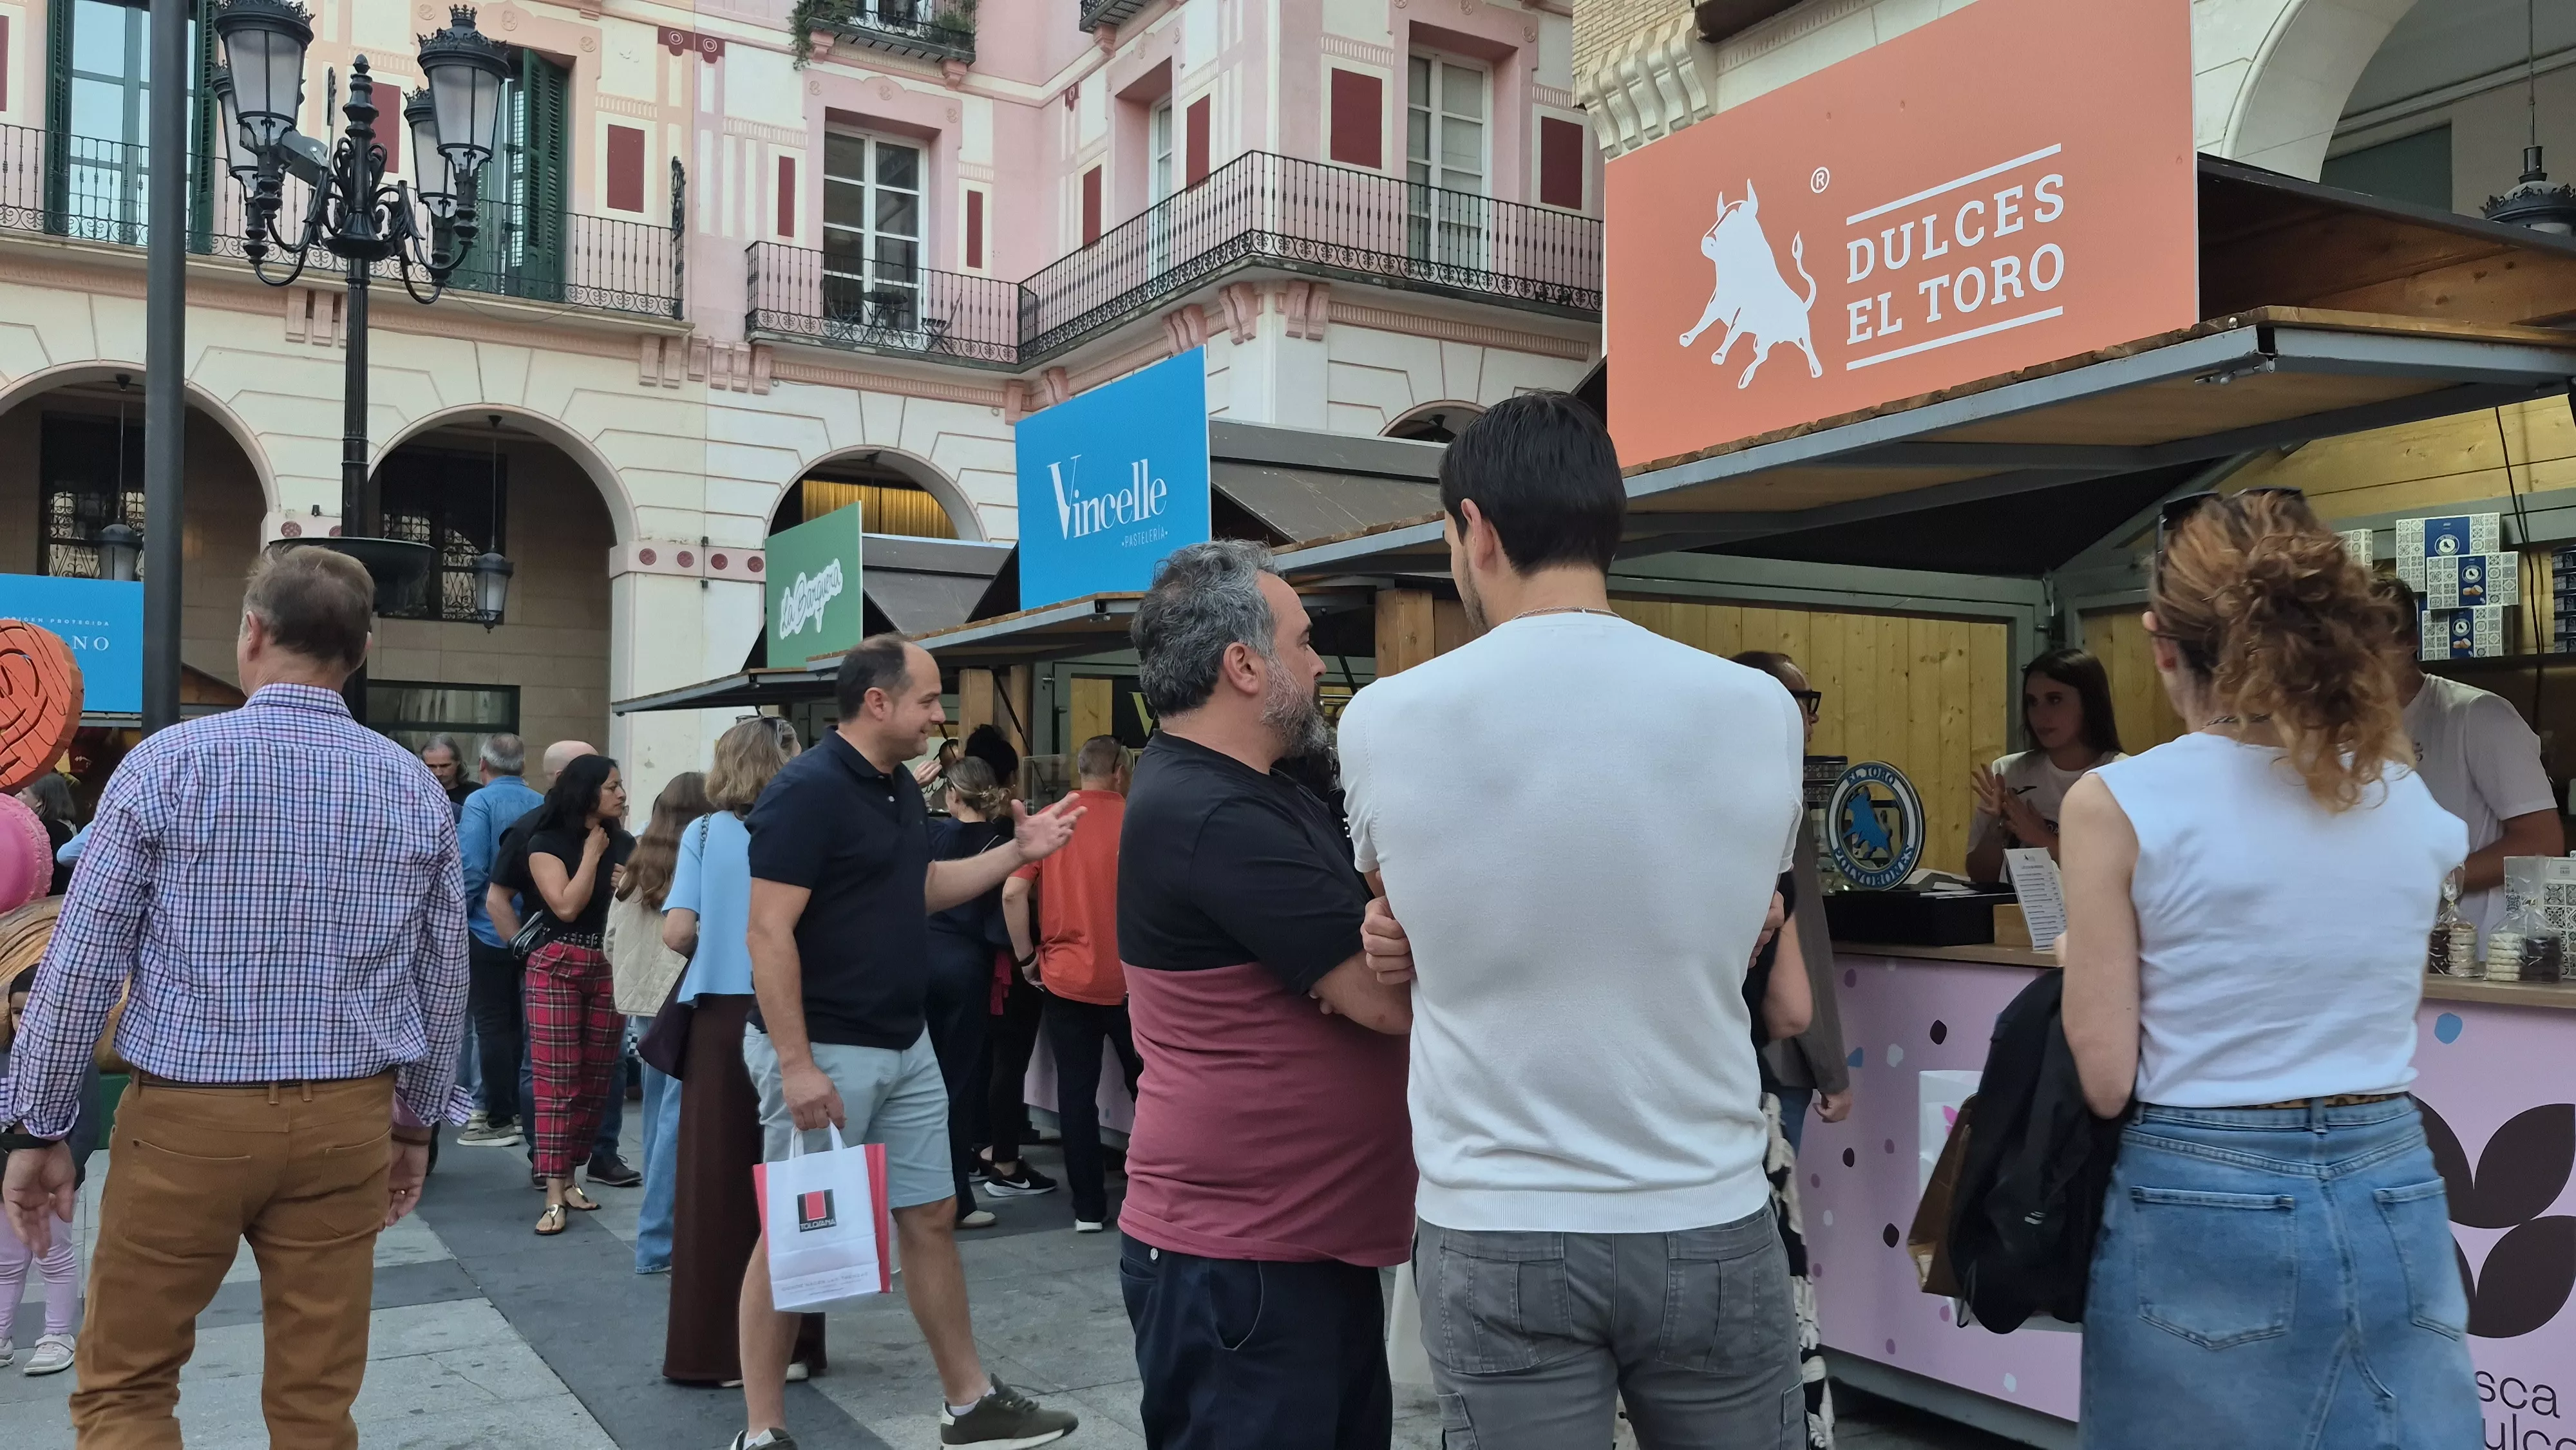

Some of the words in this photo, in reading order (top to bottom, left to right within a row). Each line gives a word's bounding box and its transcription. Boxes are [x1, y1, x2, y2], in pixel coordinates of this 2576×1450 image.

[1846, 174, 2064, 284] DULCES
[1846, 291, 1902, 345] EL
[1918, 243, 2065, 323] TORO
[1047, 455, 1167, 540] Vincelle
[781, 594, 795, 633] La
[794, 566, 841, 626] Barquera
[70, 635, 109, 651] NO
[2475, 1371, 2561, 1419] sca
[2483, 1413, 2576, 1450] ulc
